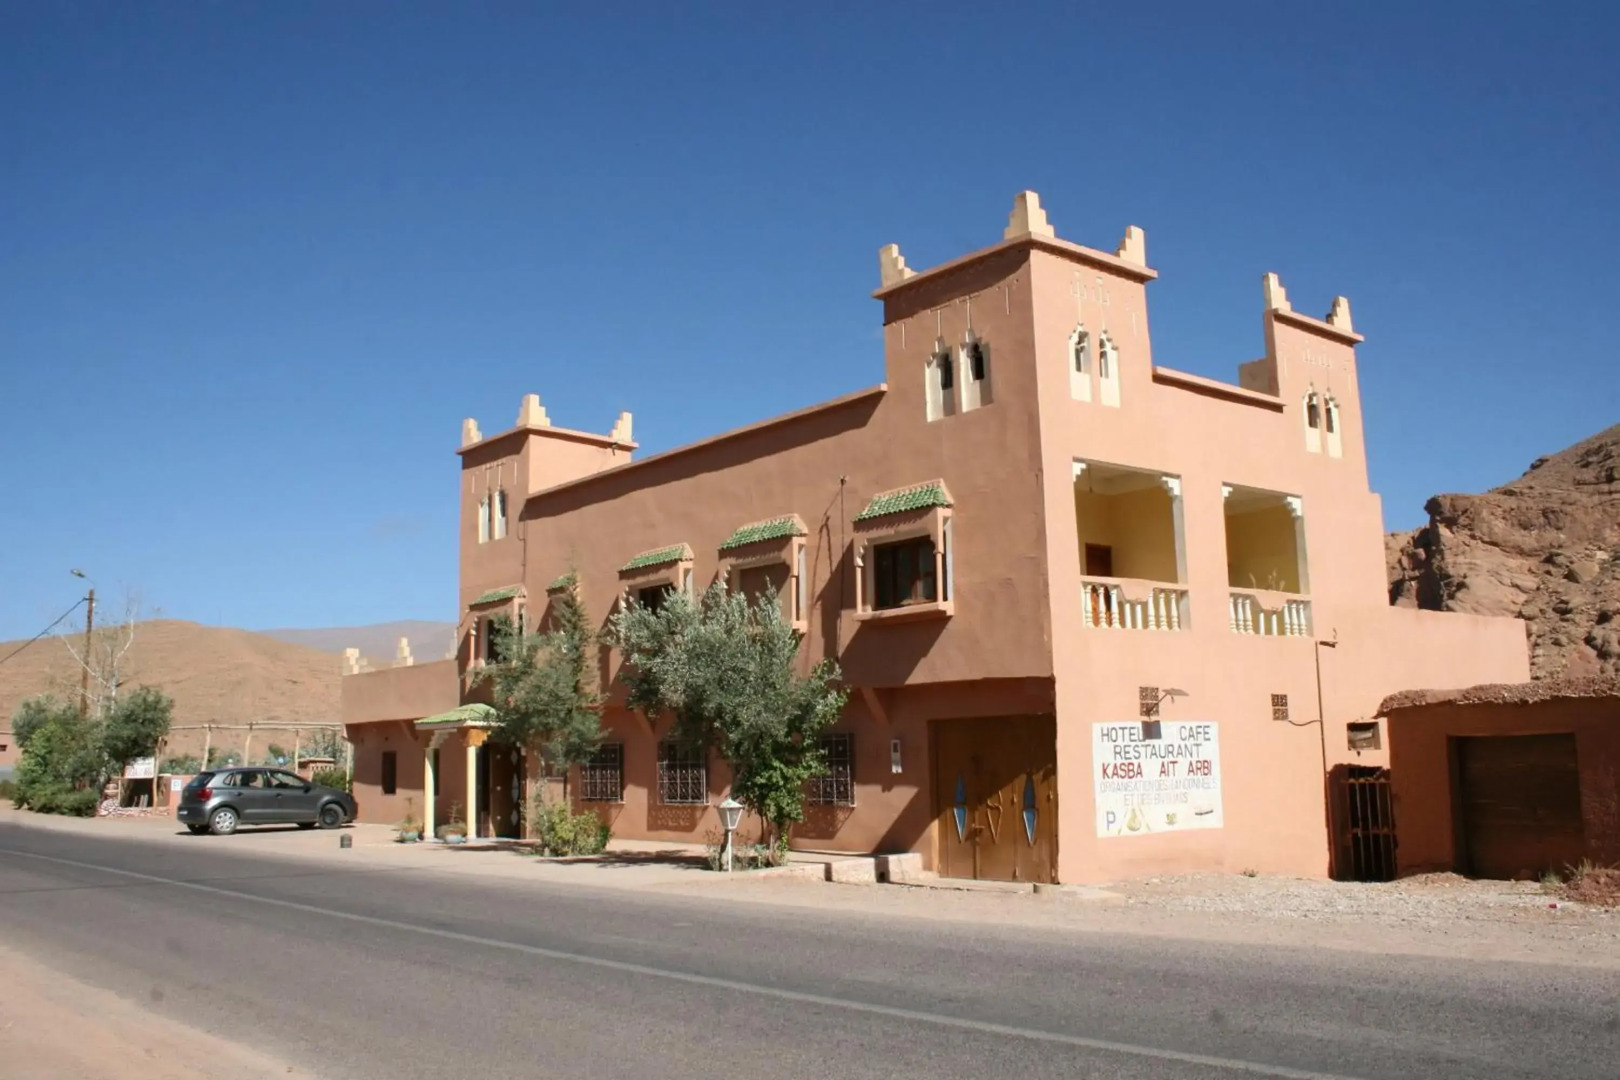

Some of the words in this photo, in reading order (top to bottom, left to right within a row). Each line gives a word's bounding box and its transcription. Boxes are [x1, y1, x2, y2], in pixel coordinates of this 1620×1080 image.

[1101, 727, 1146, 742] HOTEL
[1180, 725, 1211, 741] CAFE
[1113, 743, 1202, 760] RESTAURANT
[1102, 762, 1143, 779] KASBA
[1159, 761, 1178, 777] AIT
[1187, 760, 1212, 776] ARBI
[1106, 811, 1116, 831] P
